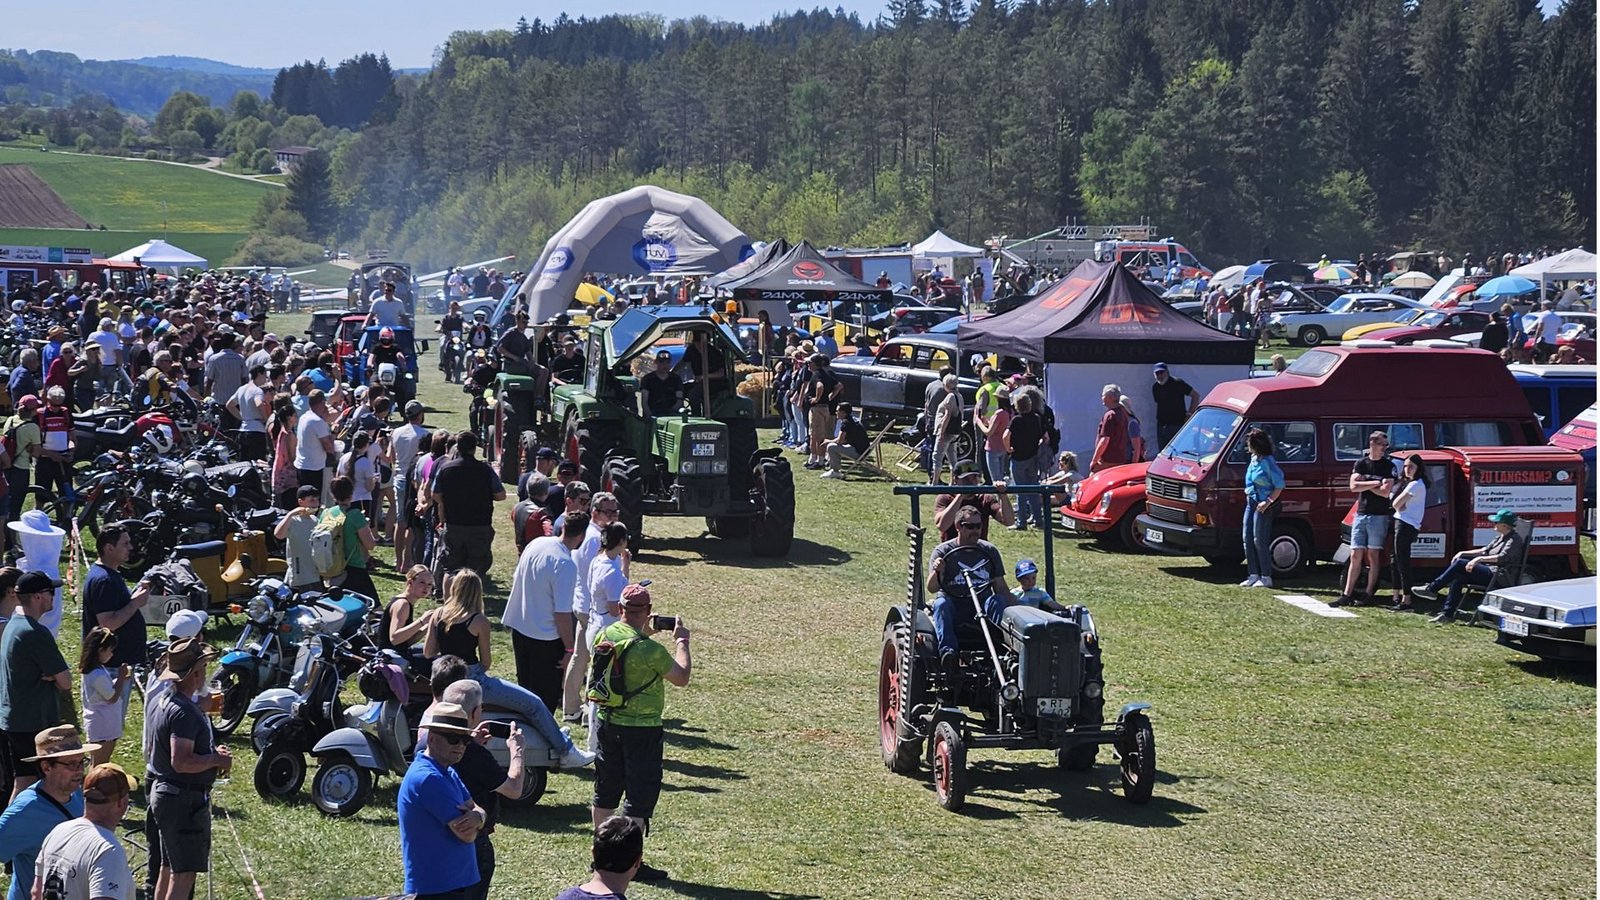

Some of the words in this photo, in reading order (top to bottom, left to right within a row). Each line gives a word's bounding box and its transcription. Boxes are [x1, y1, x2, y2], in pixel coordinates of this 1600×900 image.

[787, 278, 836, 286] 24MX
[762, 291, 806, 300] 24MX
[838, 292, 882, 301] 24MX
[1480, 470, 1493, 483] ZU
[1494, 470, 1553, 483] LANGSAM?
[165, 601, 181, 615] 40
[1050, 699, 1063, 708] RT
